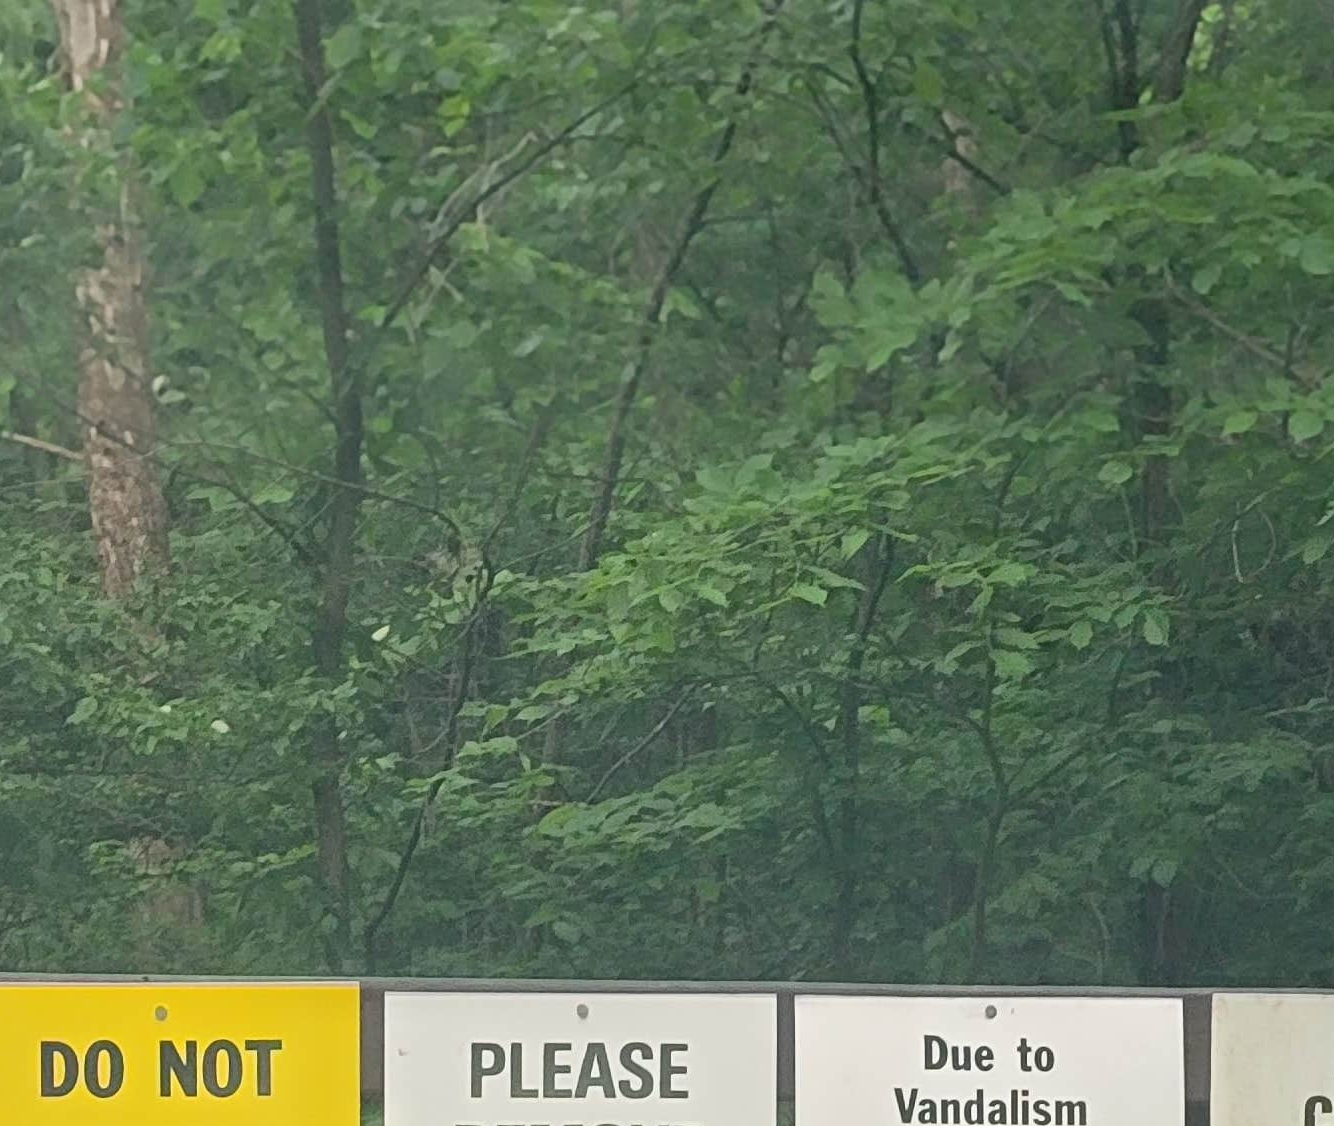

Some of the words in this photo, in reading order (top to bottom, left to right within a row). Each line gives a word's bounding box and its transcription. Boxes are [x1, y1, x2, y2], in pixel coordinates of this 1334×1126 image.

[40, 1039, 125, 1099] DO
[158, 1038, 283, 1099] NOT
[470, 1041, 689, 1100] PLEASE
[923, 1034, 995, 1072] Due
[1016, 1037, 1055, 1073] to
[893, 1087, 1087, 1126] Vandalism
